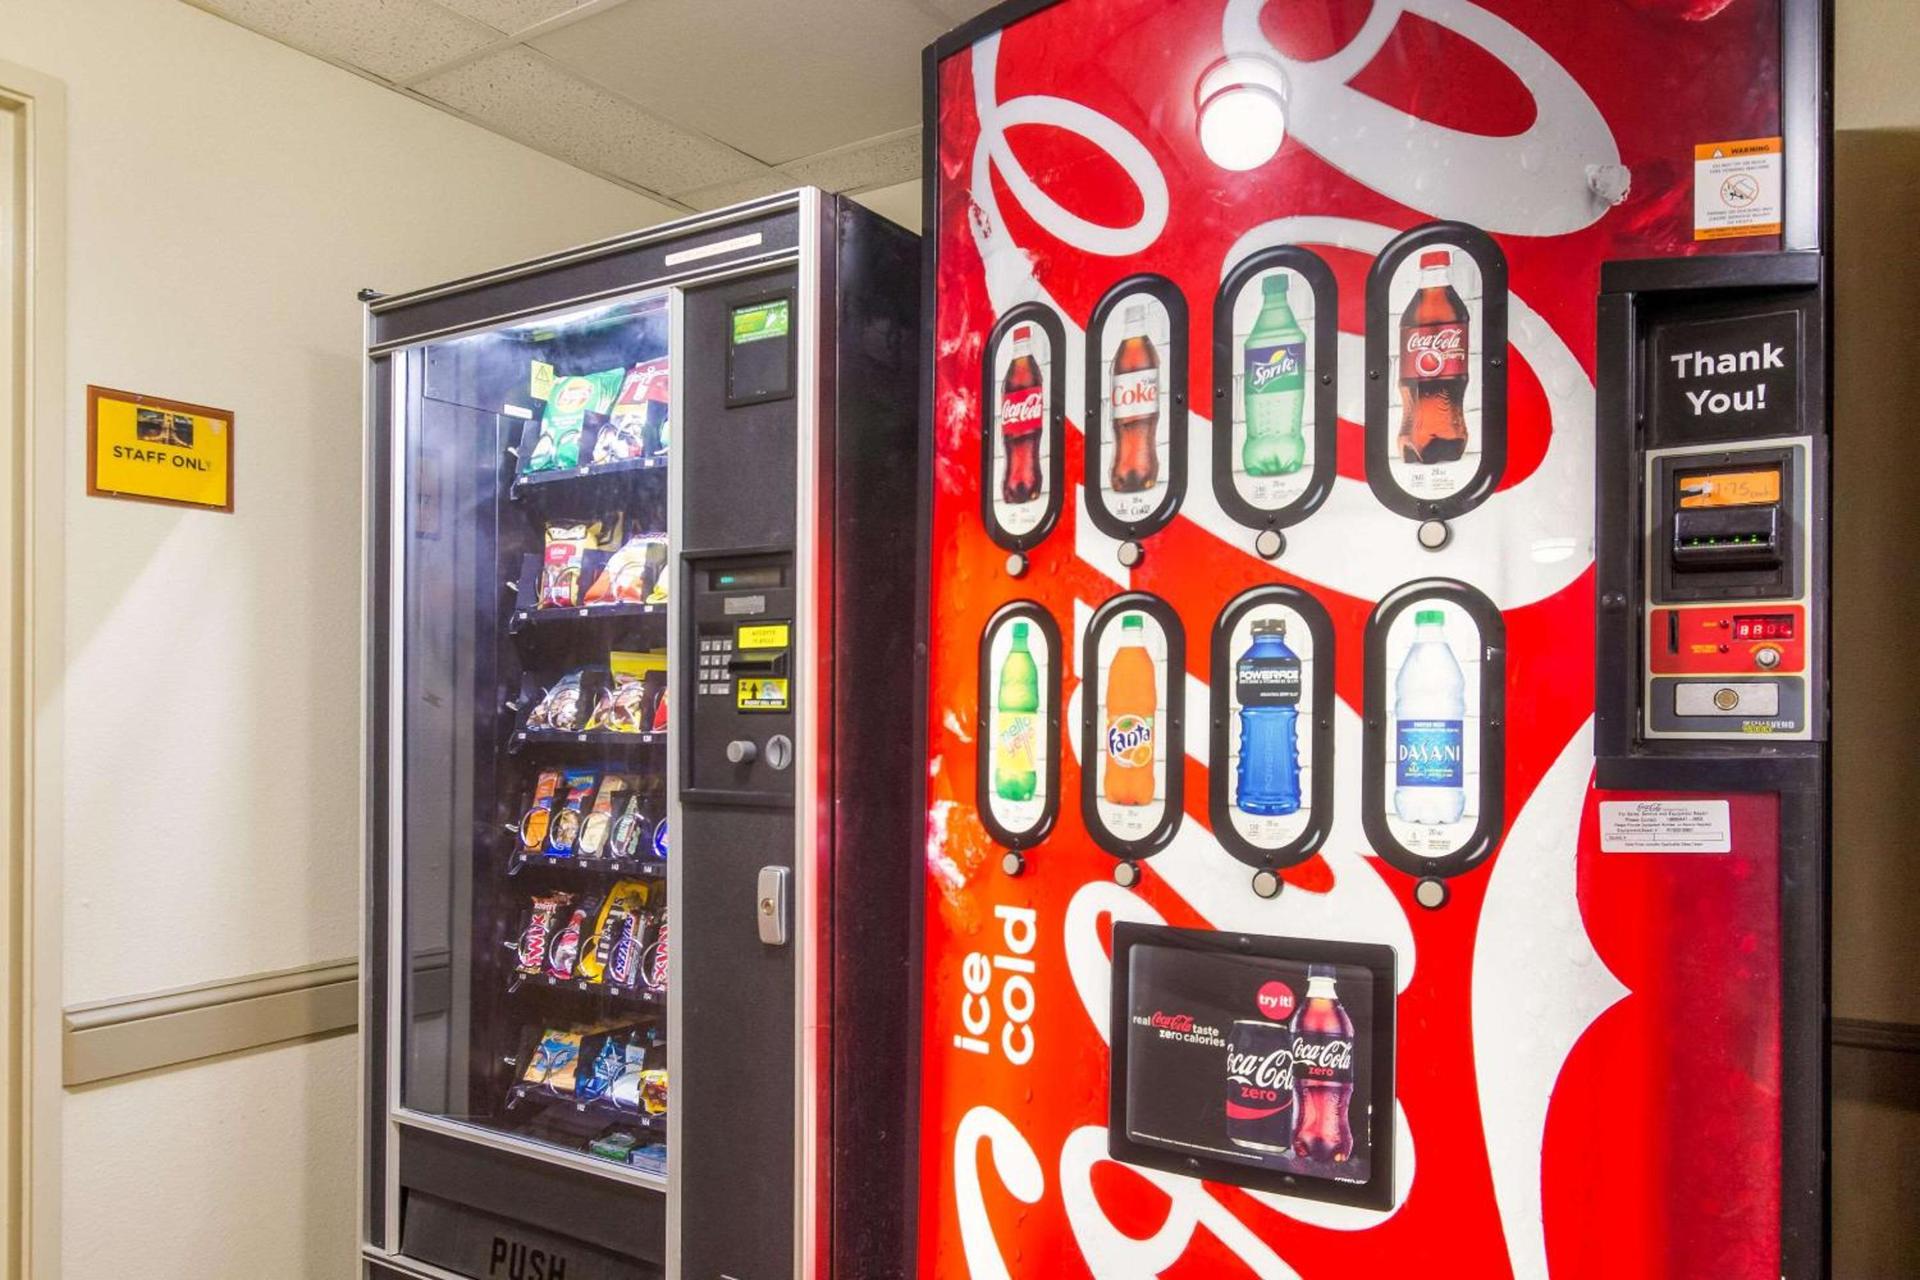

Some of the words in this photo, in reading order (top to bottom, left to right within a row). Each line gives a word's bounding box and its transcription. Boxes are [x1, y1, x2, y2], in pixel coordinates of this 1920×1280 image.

[1731, 145, 1770, 155] WARNING
[1407, 328, 1463, 352] Coca-Cola
[1253, 358, 1295, 385] Sprite
[1670, 342, 1785, 379] Thank
[1111, 382, 1158, 408] Coke
[1685, 384, 1766, 416] You!
[1001, 393, 1042, 425] Coca-Cola
[112, 445, 167, 464] STAFF
[1239, 670, 1299, 680] POWERADE
[1109, 724, 1151, 756] Fanta
[1399, 742, 1460, 763] DASANI
[993, 904, 1037, 1066] cold
[953, 951, 992, 1055] ice
[1259, 994, 1278, 1008] try
[1279, 994, 1293, 1007] it!
[1132, 1014, 1151, 1025] real
[1151, 1011, 1195, 1032] Coca-Cola
[1192, 1023, 1219, 1036] taste
[1159, 1029, 1183, 1040] zero
[1183, 1033, 1226, 1047] calories
[1292, 1036, 1353, 1070] Coca-Cola
[1308, 1066, 1335, 1076] zero
[1240, 1085, 1278, 1101] zero
[489, 1236, 567, 1280] PUSH
